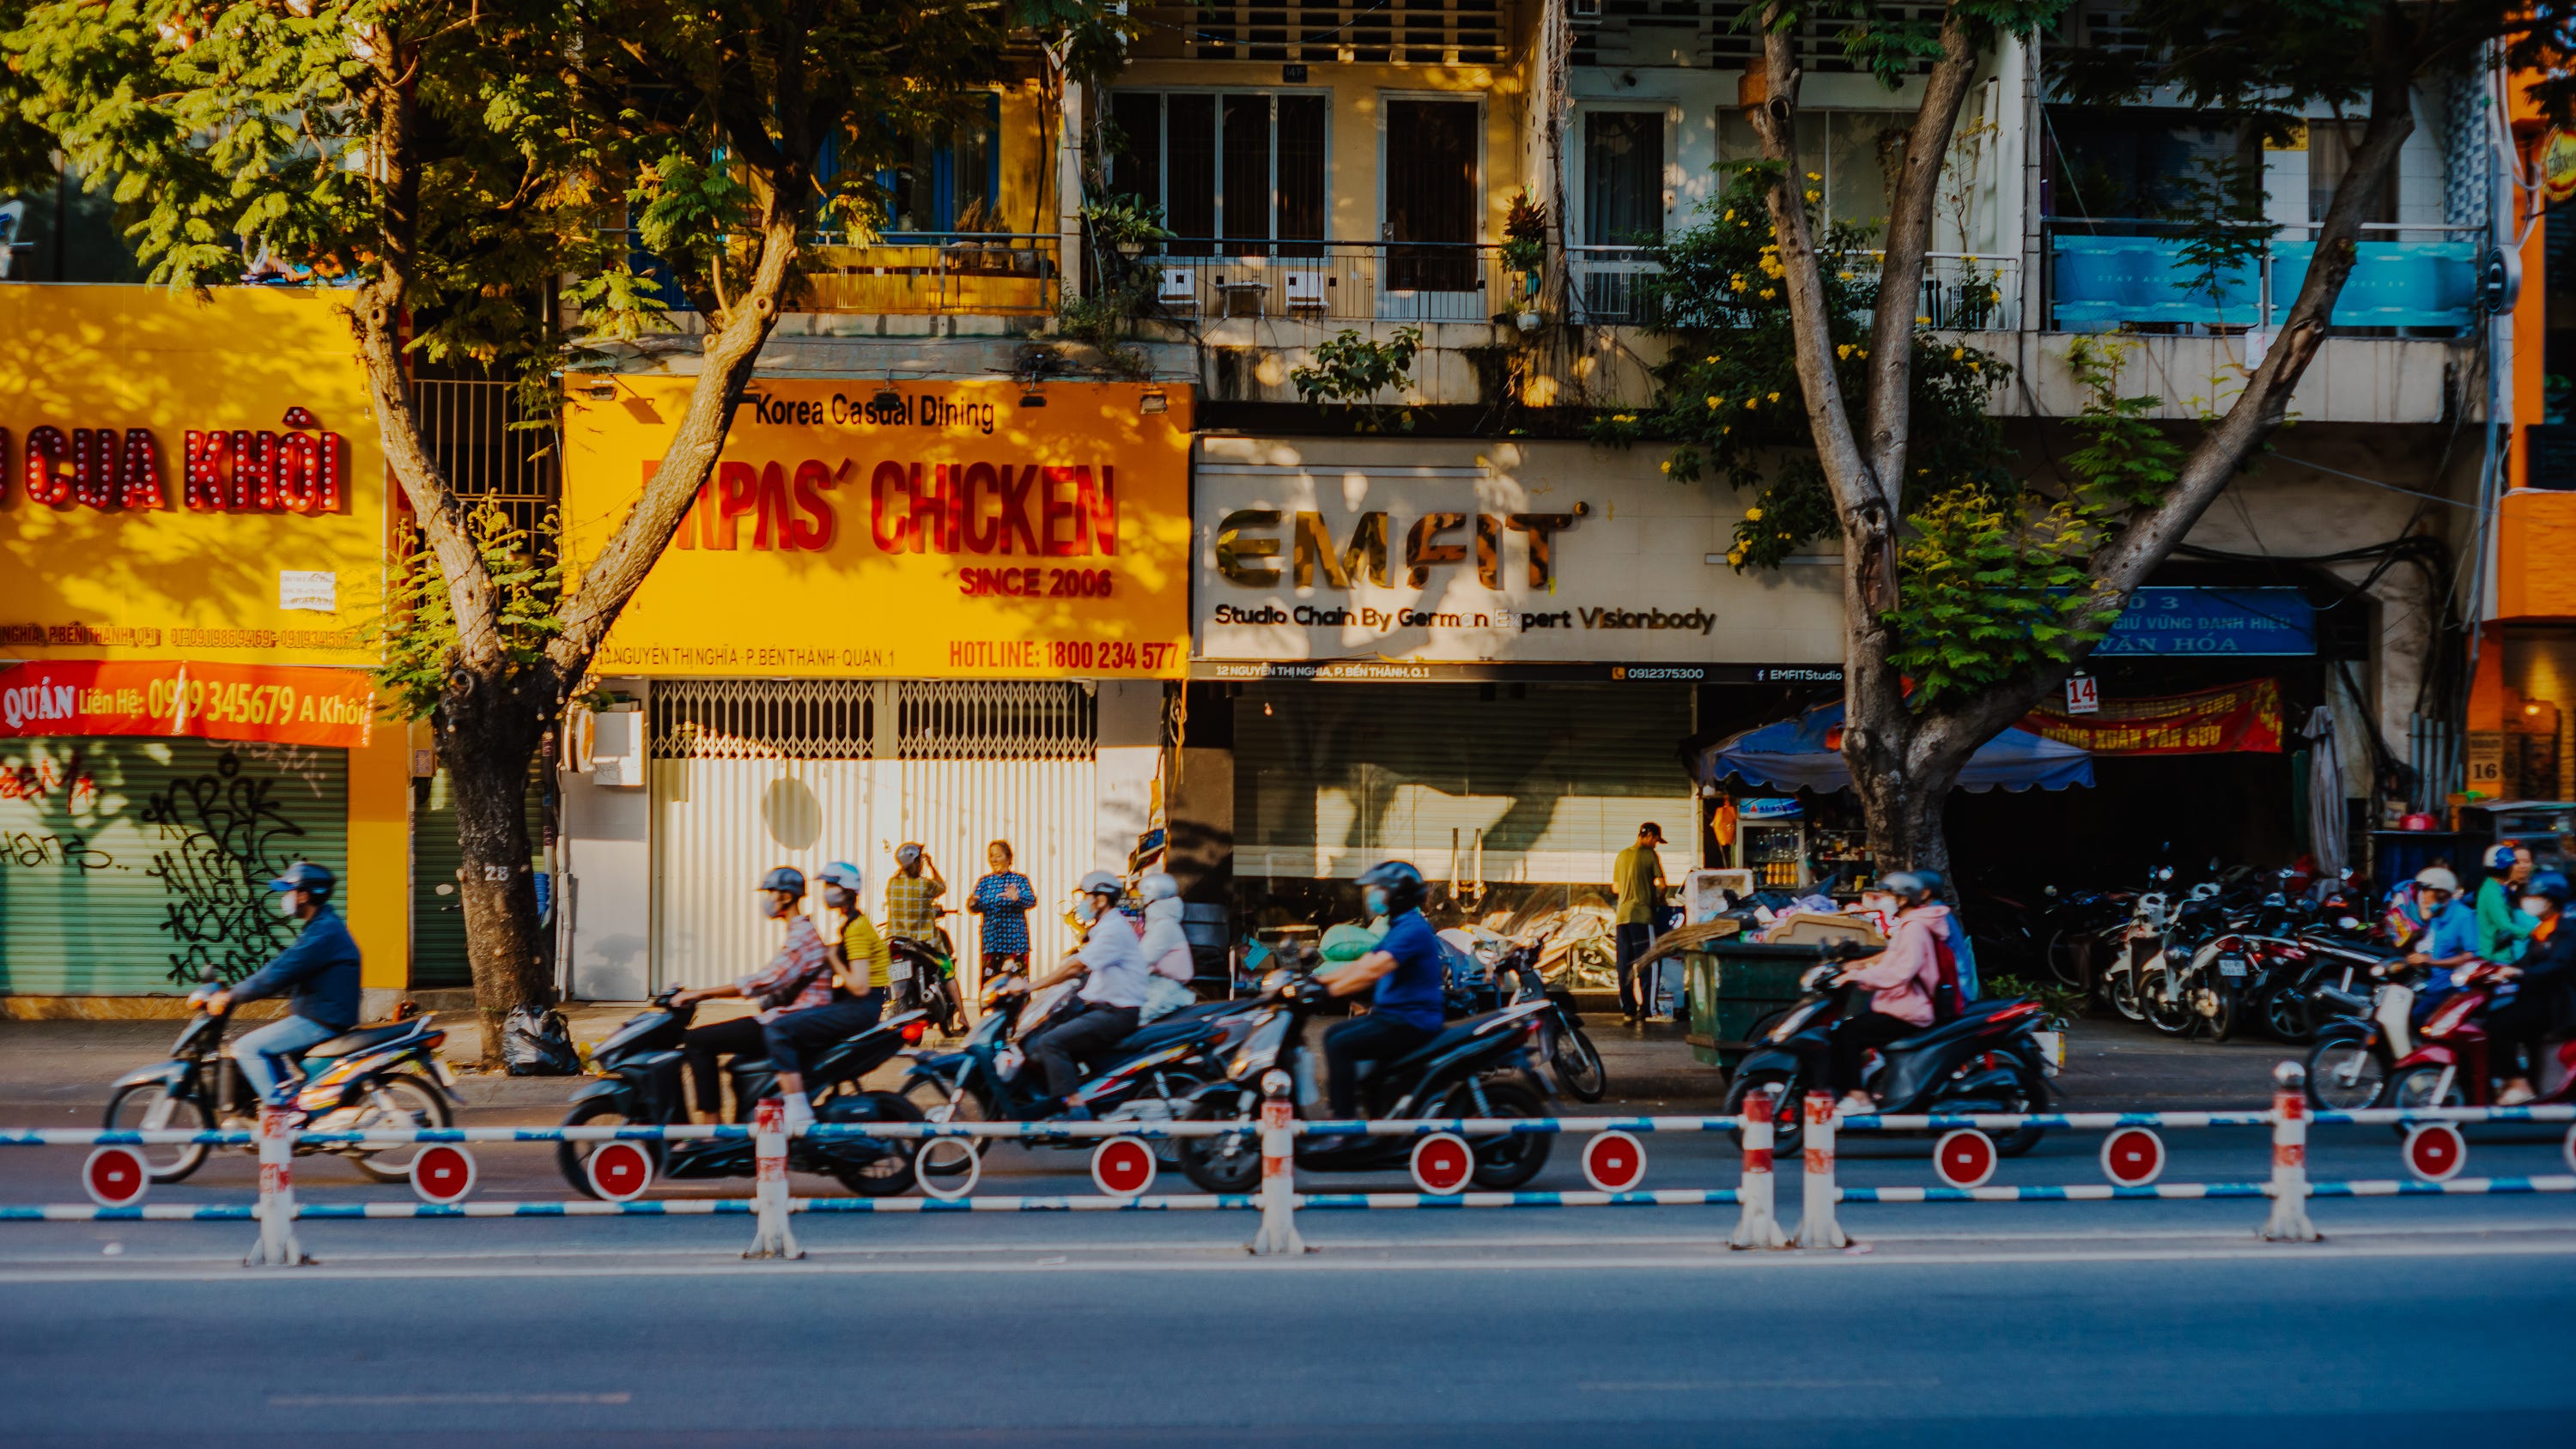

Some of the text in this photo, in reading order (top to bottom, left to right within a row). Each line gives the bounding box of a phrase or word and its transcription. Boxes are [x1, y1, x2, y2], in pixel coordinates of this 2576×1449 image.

[756, 393, 994, 435] Korea Casual Dining
[25, 424, 166, 510] CUA
[184, 406, 341, 512] KHÔI
[642, 458, 1115, 556] APAS' CHICKEN
[1215, 508, 1575, 591] EMFIT
[959, 567, 1113, 598] SINCE 2006
[2160, 596, 2180, 609] 3
[1215, 603, 1716, 635] Studio Chain By German Expert Visionbody
[2198, 616, 2245, 630] DANH
[950, 640, 1179, 670] HOTLINE: 1800 234 577
[2172, 632, 2240, 652] HÓA
[1216, 664, 1230, 676] 12
[1278, 665, 1296, 678] THỊ
[1627, 668, 1704, 680] 0912375300
[1770, 669, 1843, 682] EMFITStudio
[3, 676, 76, 728] QUÁN
[79, 688, 112, 714] Liên
[116, 689, 144, 717] Hệ:
[206, 680, 296, 725] 345679
[299, 695, 316, 722] A
[2069, 677, 2097, 703] 14
[2474, 762, 2497, 779] 16
